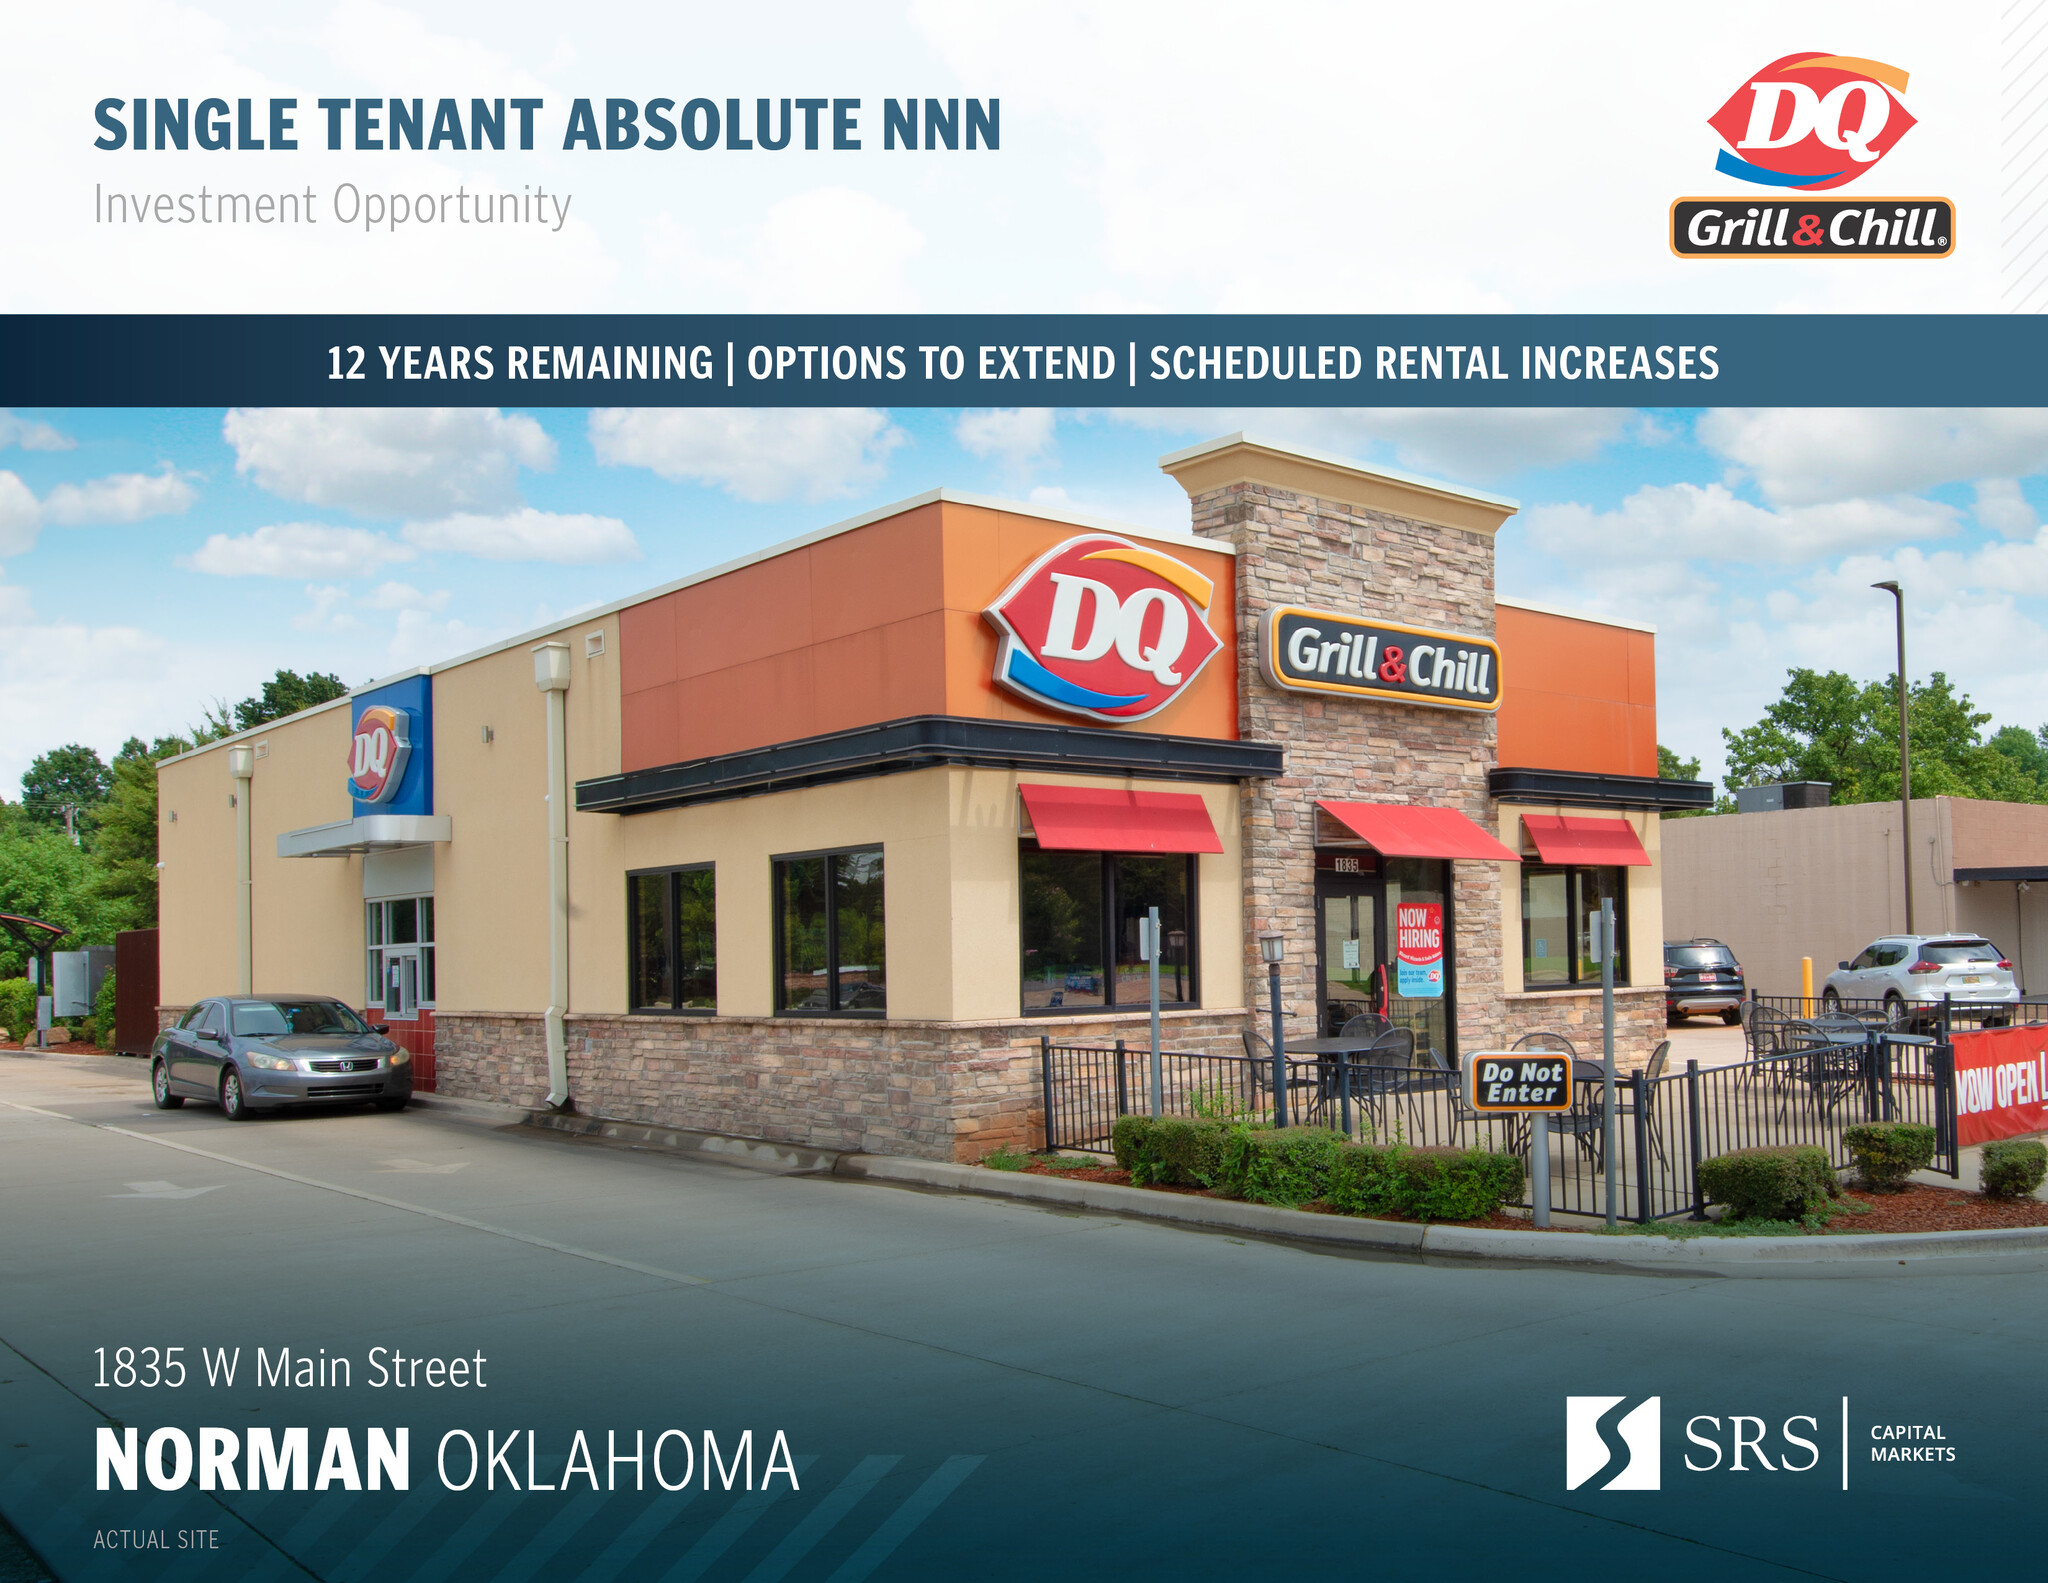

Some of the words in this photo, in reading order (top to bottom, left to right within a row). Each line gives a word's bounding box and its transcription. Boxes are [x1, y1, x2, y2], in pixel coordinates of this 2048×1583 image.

[1040, 572, 1189, 686] DQ
[354, 727, 388, 778] DQ
[1336, 859, 1358, 871] 1835
[1399, 908, 1427, 927] NOW
[1400, 929, 1440, 948] HIRING
[1482, 1062, 1514, 1082] Do
[1519, 1062, 1563, 1082] Not
[1487, 1083, 1557, 1103] Enter
[1955, 1066, 1993, 1116] NOW
[1995, 1060, 2039, 1108] OPEN
